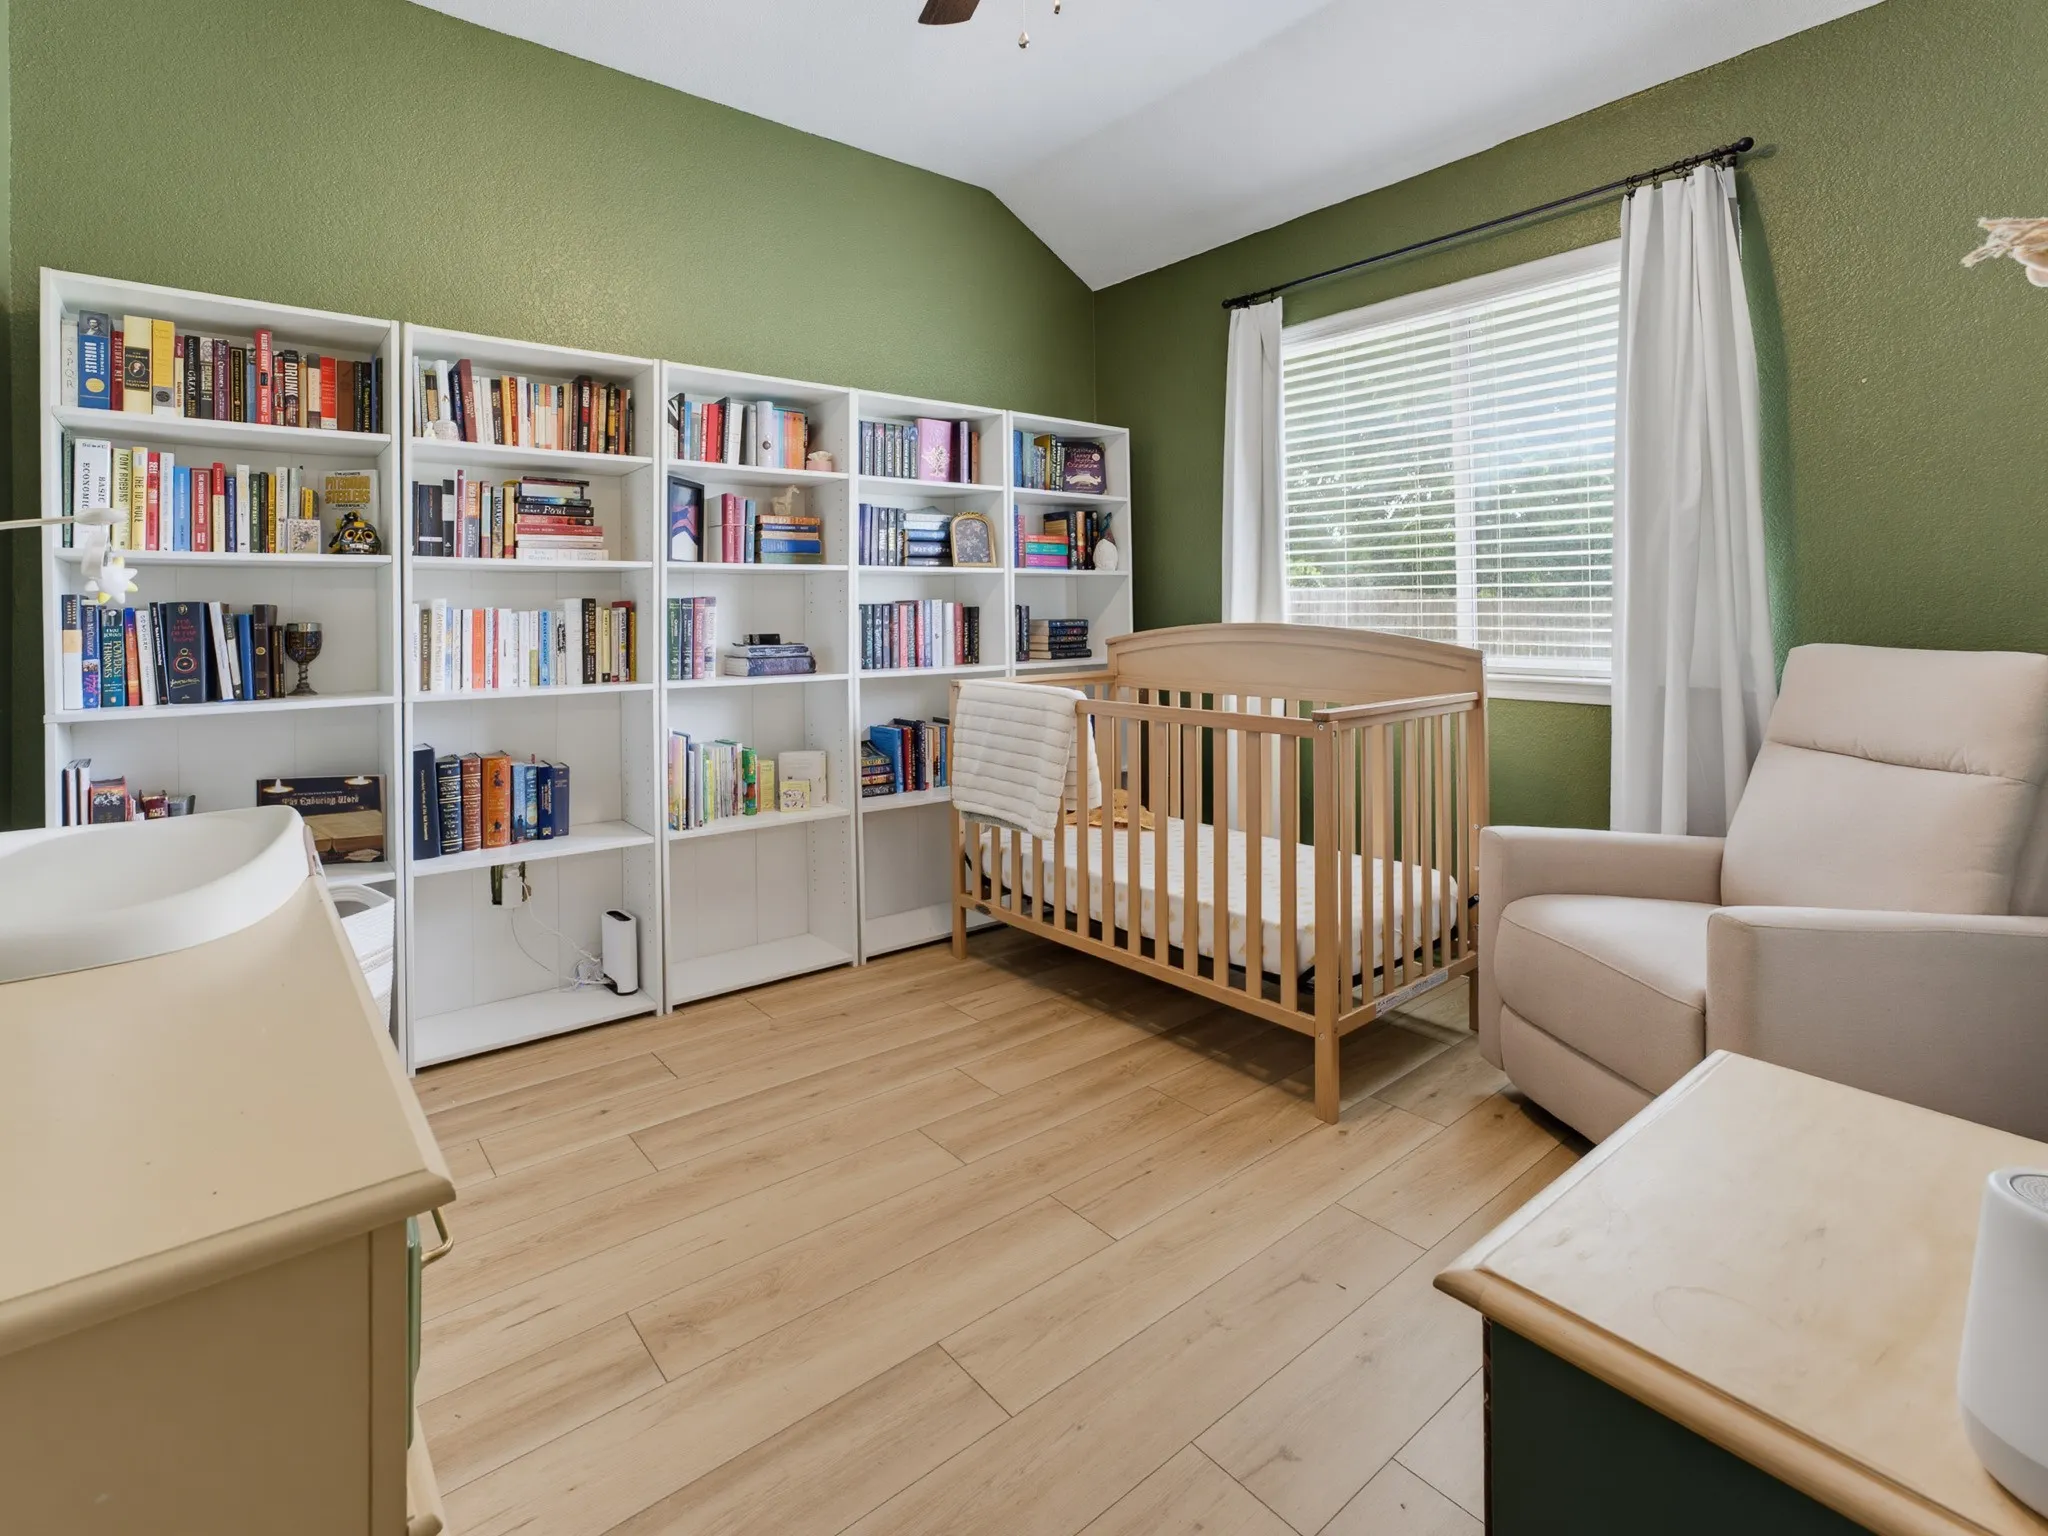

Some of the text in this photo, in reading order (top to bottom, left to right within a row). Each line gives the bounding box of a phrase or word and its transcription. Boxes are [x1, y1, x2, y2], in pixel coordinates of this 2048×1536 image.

[84, 342, 97, 373] DOUGLASS
[285, 363, 298, 397] DRUNK
[82, 463, 90, 509] ECONOMIC
[119, 454, 128, 502] TONY ROBBINS
[134, 476, 143, 489] THE
[325, 490, 370, 504] STEELERS
[543, 506, 566, 514] Paul
[134, 506, 143, 522] RULE
[104, 641, 112, 678] THRONES
[113, 641, 121, 674] POWERS
[300, 797, 336, 806] Enduring
[338, 795, 360, 803] Word
